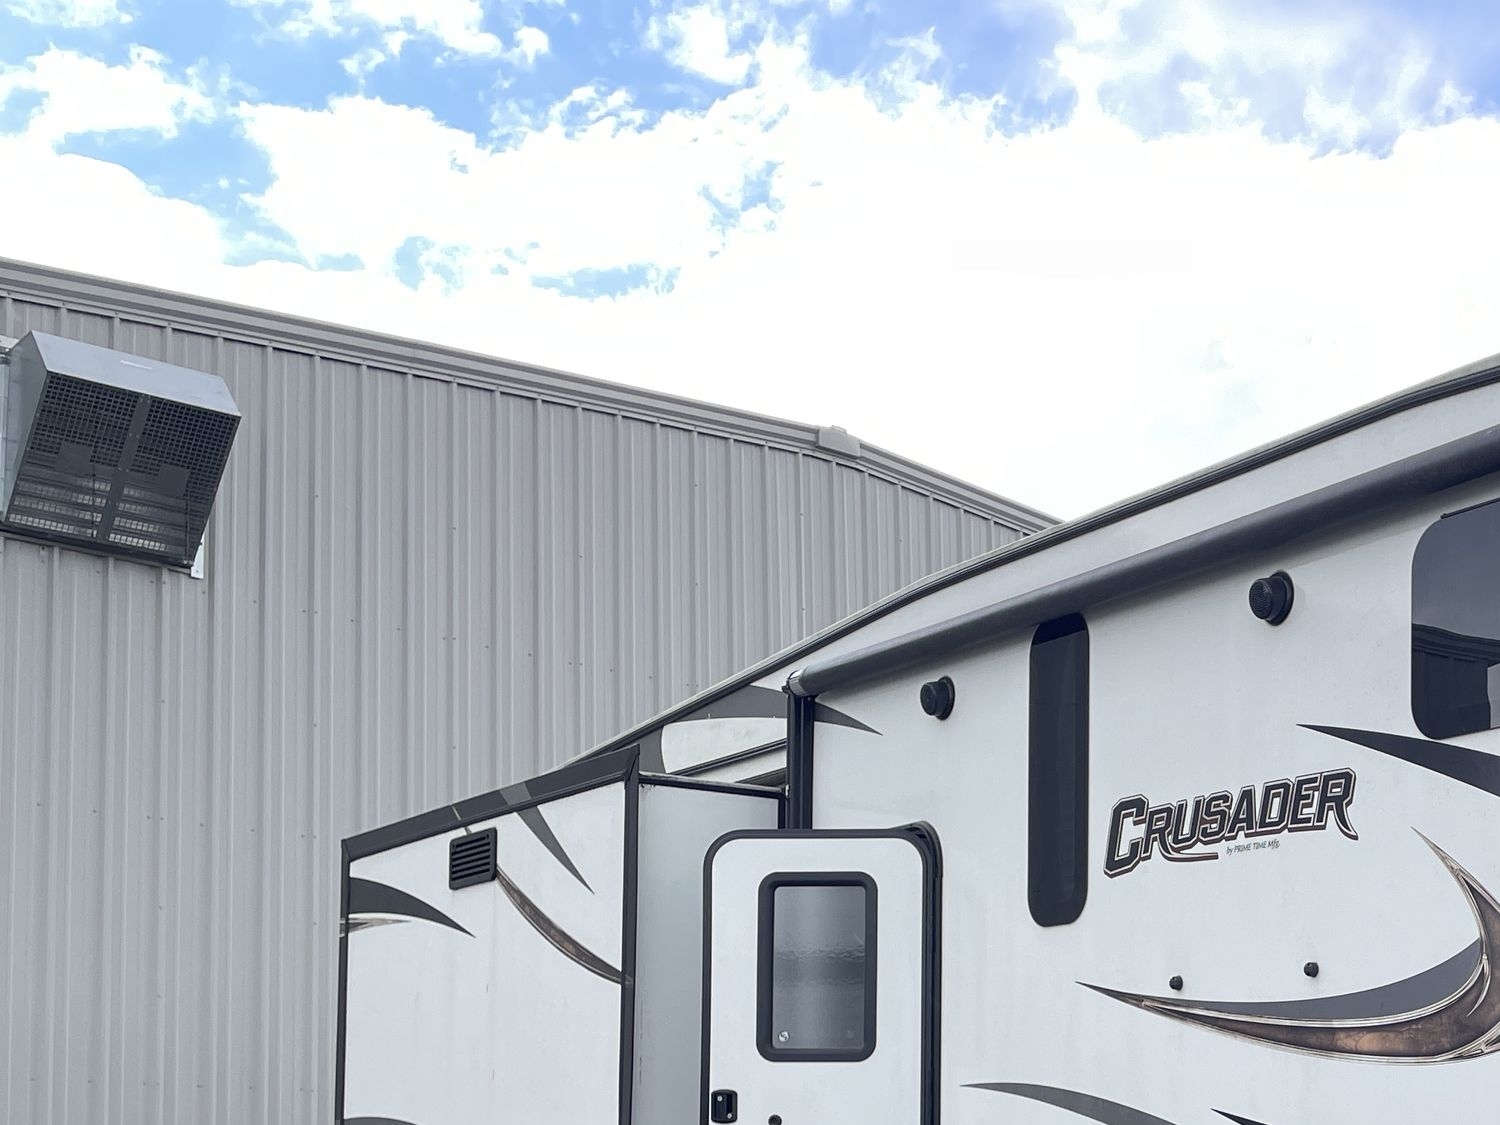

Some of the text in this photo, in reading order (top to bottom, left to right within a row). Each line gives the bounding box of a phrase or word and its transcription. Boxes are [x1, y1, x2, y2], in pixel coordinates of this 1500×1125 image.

[1103, 767, 1359, 879] CRUSADER
[1234, 843, 1252, 853] PRIME
[1253, 840, 1268, 850] TIME
